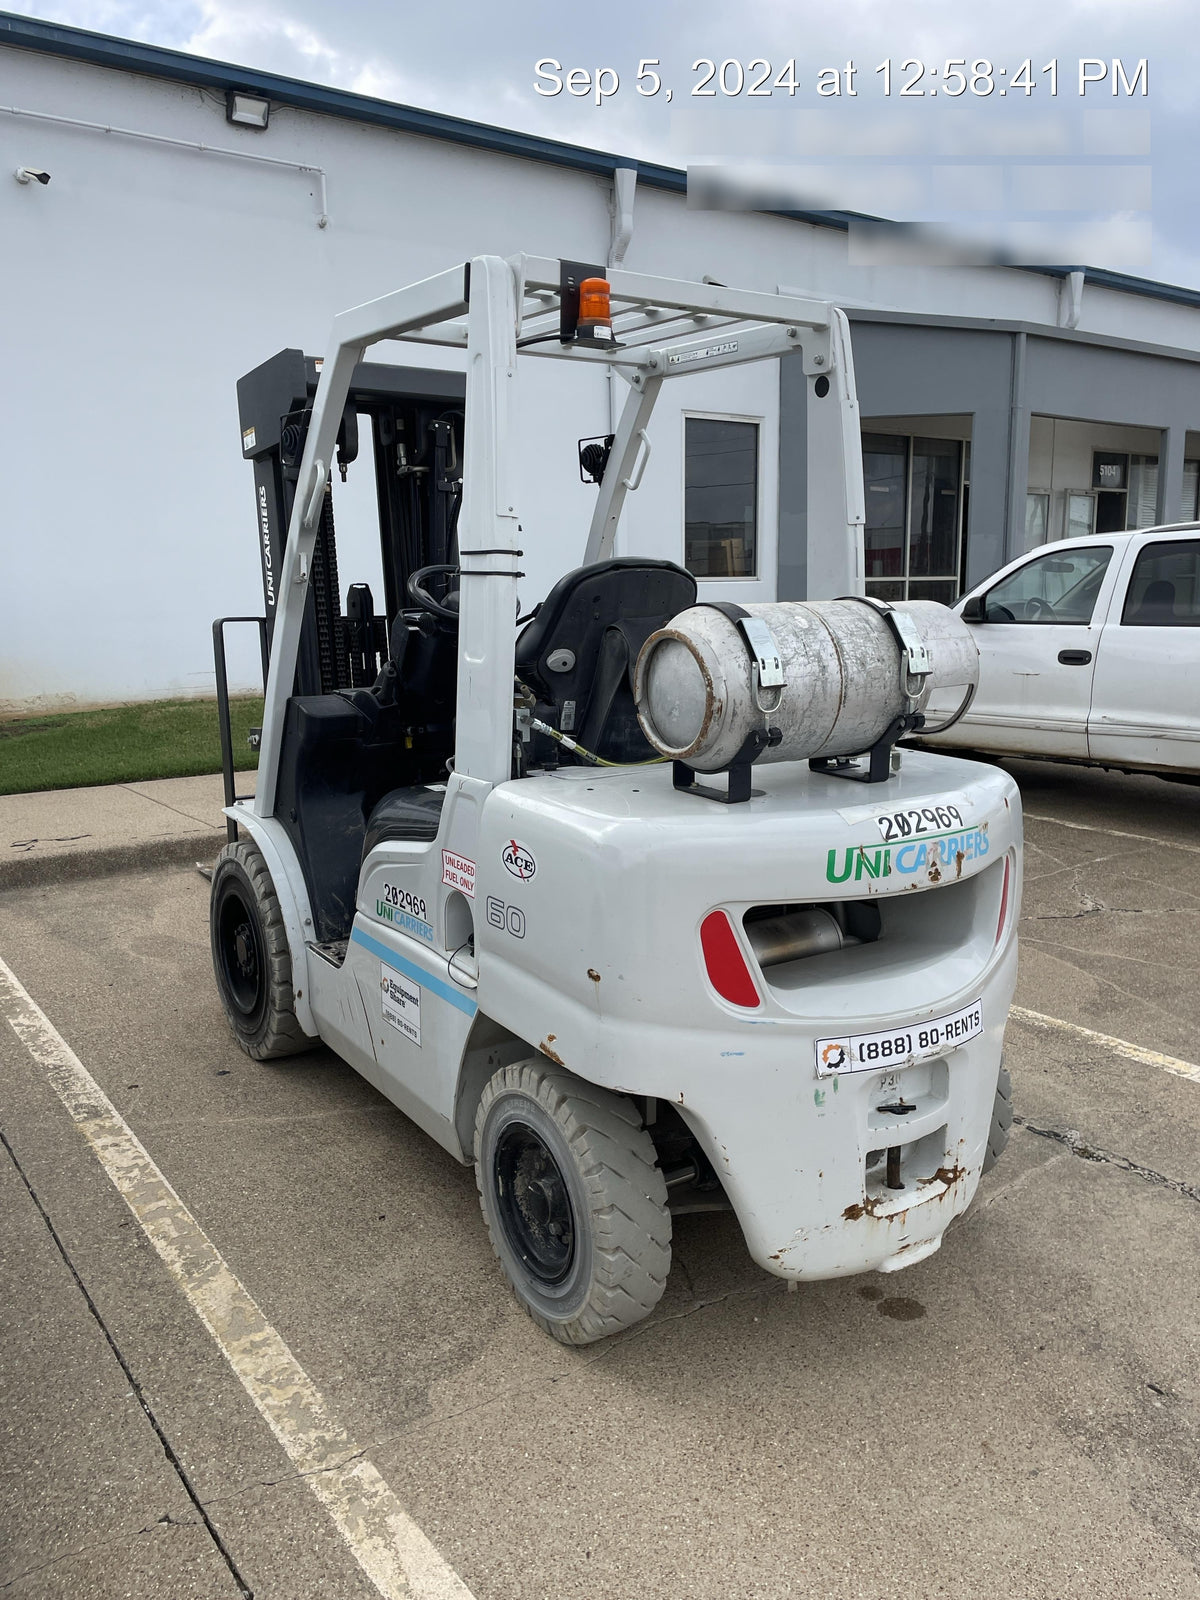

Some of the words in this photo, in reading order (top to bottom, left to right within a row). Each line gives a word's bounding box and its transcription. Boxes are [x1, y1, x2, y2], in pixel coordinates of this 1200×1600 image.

[1099, 464, 1116, 477] 5104
[878, 805, 964, 841] 202969
[445, 854, 475, 878] UNLEADED
[504, 853, 533, 873] ACE
[445, 869, 460, 885] FUEL
[459, 876, 475, 893] ONLY
[384, 883, 427, 920] 202969
[486, 895, 526, 939] 60
[389, 979, 419, 1008] Equipment
[389, 989, 406, 1009] Share
[859, 1033, 912, 1063] (888)
[918, 1010, 980, 1048] 80-RENTS
